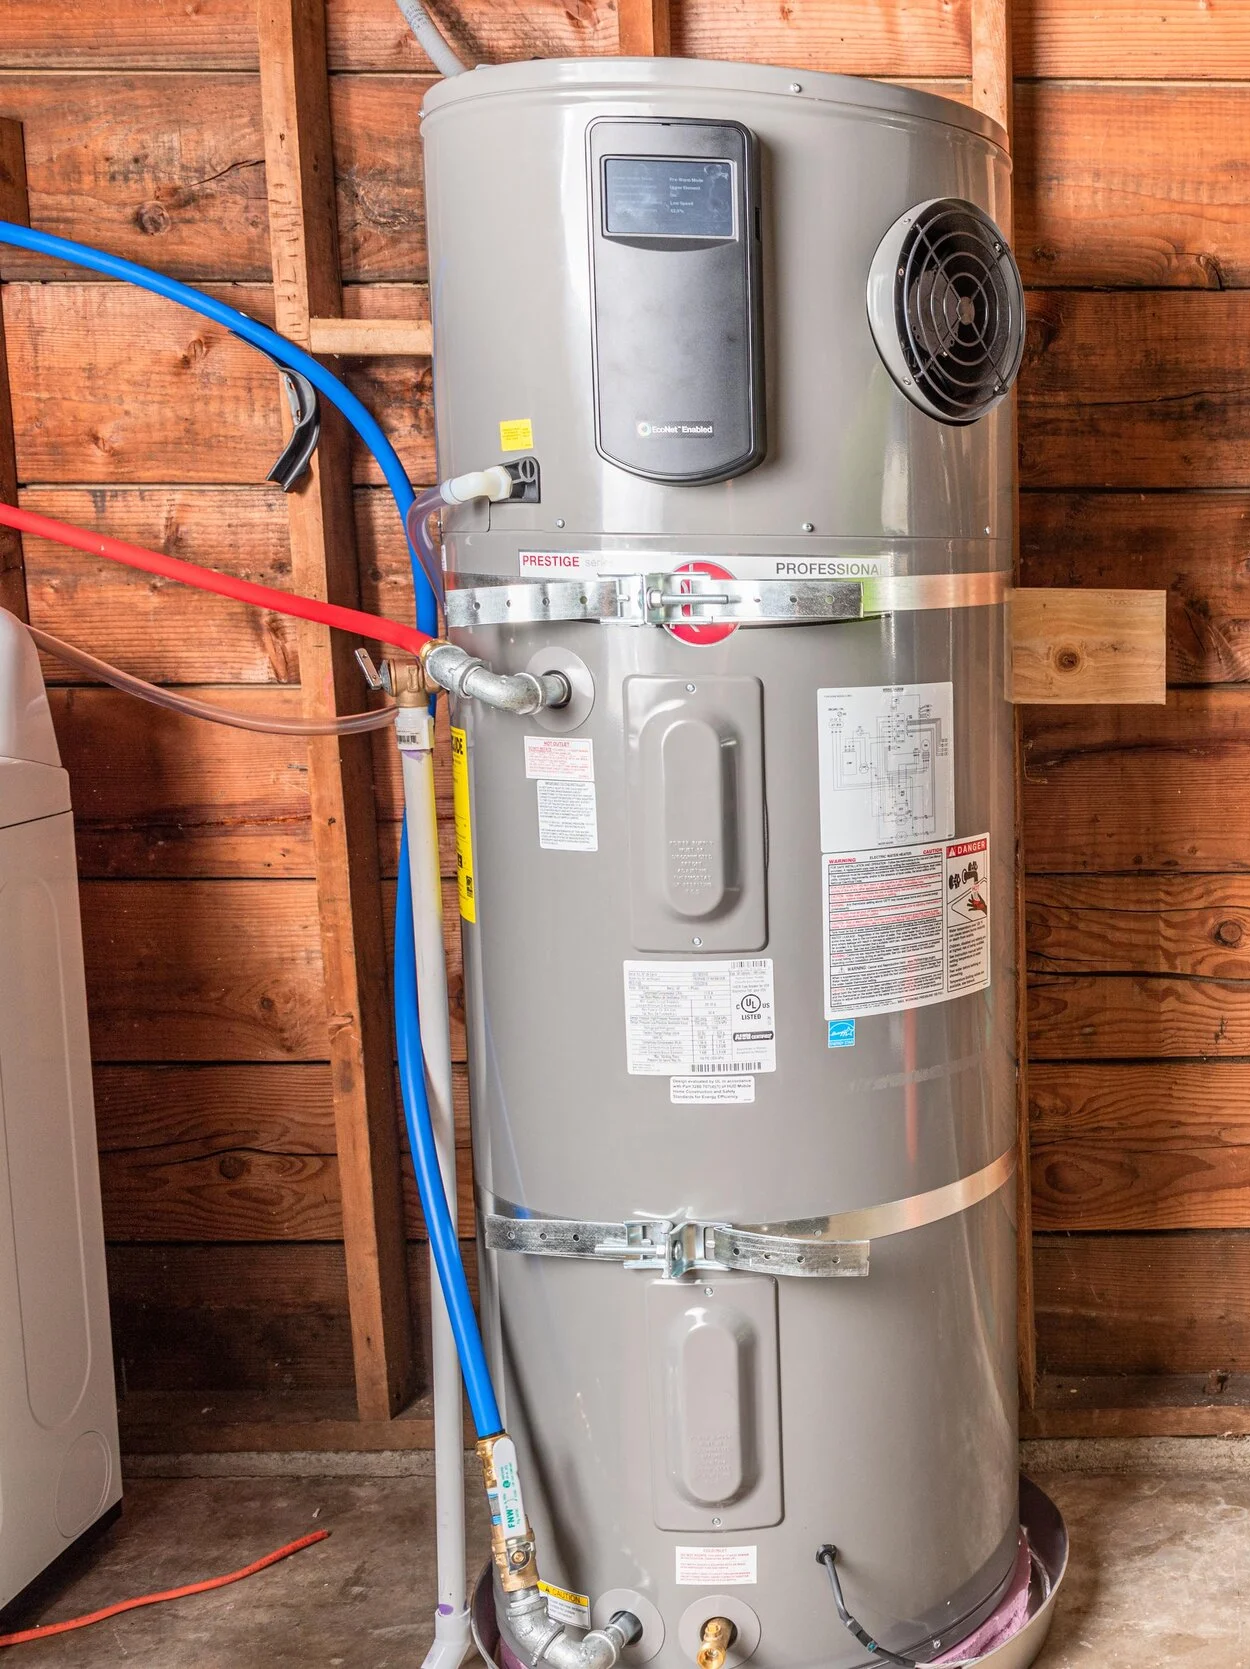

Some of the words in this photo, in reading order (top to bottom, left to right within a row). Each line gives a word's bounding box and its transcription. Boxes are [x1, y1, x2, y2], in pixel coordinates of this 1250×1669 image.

[681, 425, 713, 433] Enabled
[522, 555, 580, 567] PRESTIGE
[956, 839, 987, 855] DANGER
[506, 1509, 516, 1529] FNW
[552, 1588, 581, 1604] CAUTION
